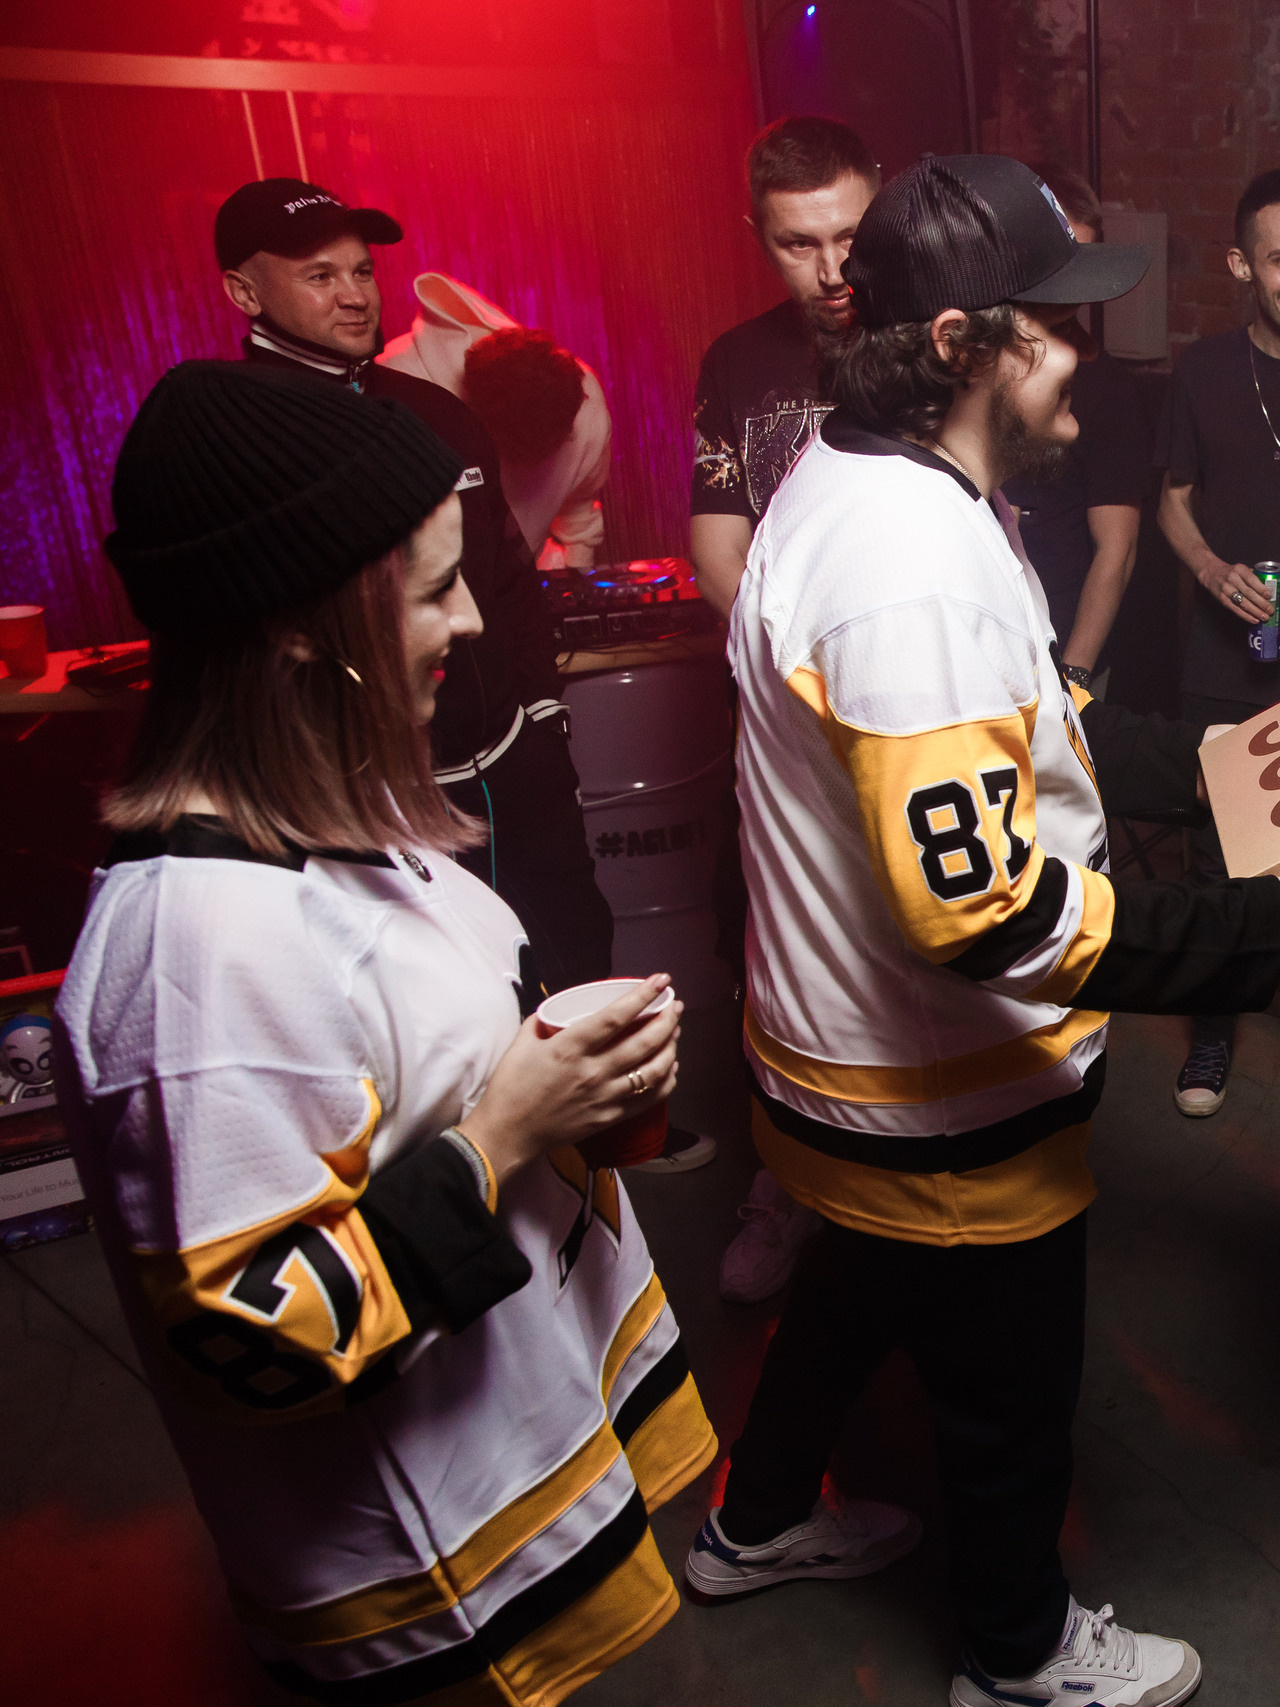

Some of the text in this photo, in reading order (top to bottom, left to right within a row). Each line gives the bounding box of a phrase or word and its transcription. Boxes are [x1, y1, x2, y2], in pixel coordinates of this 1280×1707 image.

[776, 400, 797, 410] THE
[904, 763, 1032, 903] 87
[1063, 1617, 1078, 1650] Reebok
[1061, 1681, 1094, 1692] Reebok
